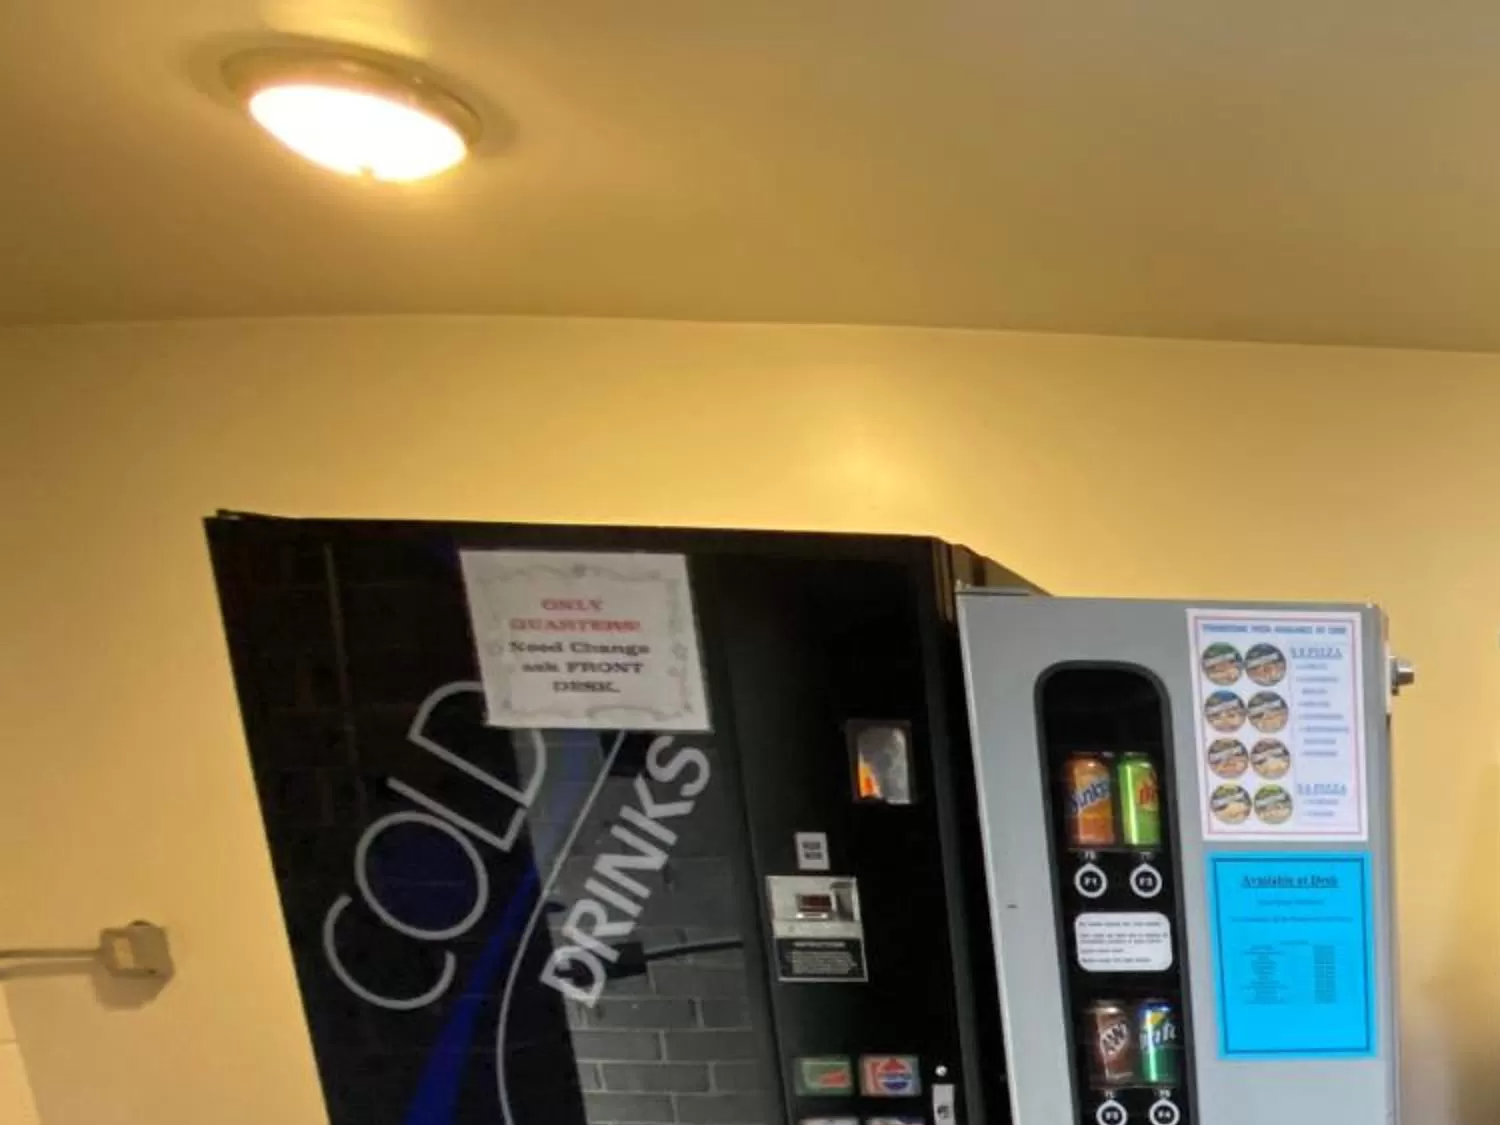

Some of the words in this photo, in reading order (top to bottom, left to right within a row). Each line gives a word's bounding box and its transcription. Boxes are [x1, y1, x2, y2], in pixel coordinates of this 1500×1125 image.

[541, 598, 604, 611] ONLY
[509, 641, 563, 653] Need
[569, 642, 650, 656] Change
[522, 662, 559, 673] ask
[566, 661, 644, 673] FRONT
[540, 735, 711, 1008] DRINKS
